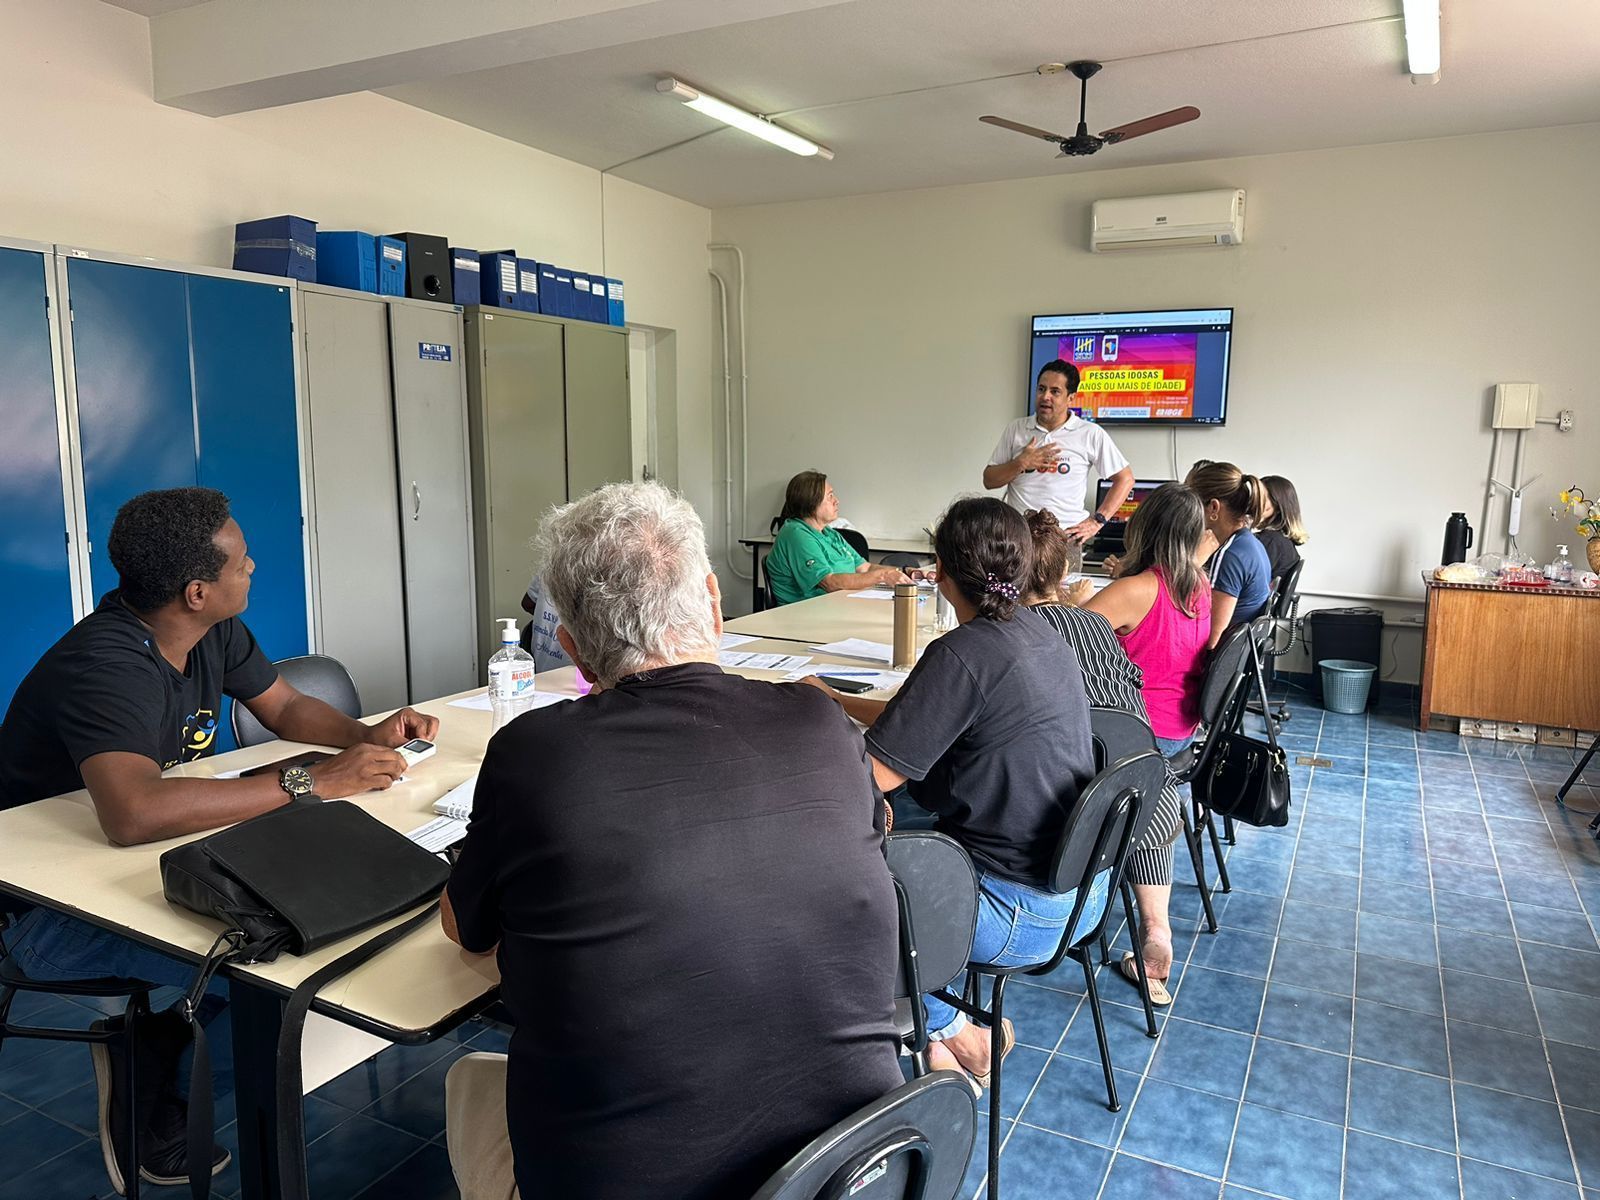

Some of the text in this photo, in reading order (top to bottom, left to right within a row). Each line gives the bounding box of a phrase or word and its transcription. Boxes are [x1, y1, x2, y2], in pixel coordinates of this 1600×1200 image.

[1089, 370, 1159, 380] PESSOAS IDOSAS
[1079, 381, 1182, 390] ANOS OU MAIS DE IDADE)
